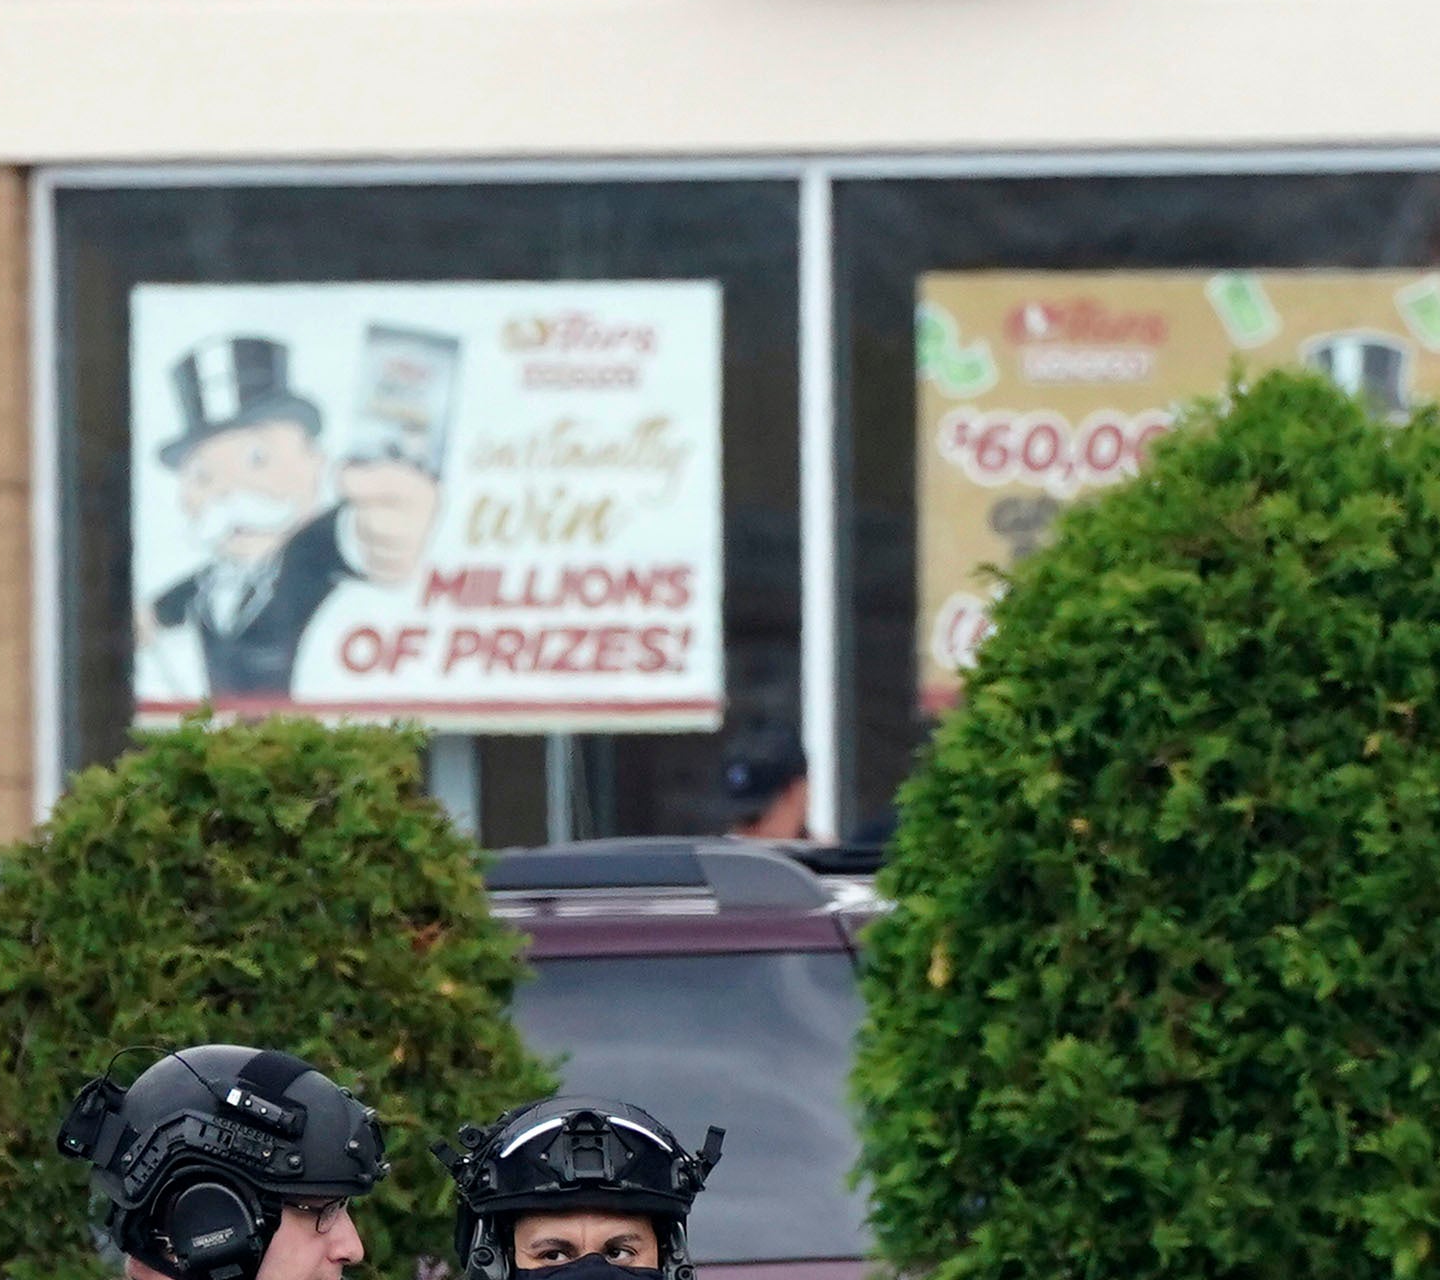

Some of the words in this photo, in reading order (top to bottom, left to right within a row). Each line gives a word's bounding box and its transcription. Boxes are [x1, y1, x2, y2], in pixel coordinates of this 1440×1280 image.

[422, 566, 693, 609] MILLIONS
[341, 626, 428, 674] OF
[444, 626, 693, 675] PRIZES!
